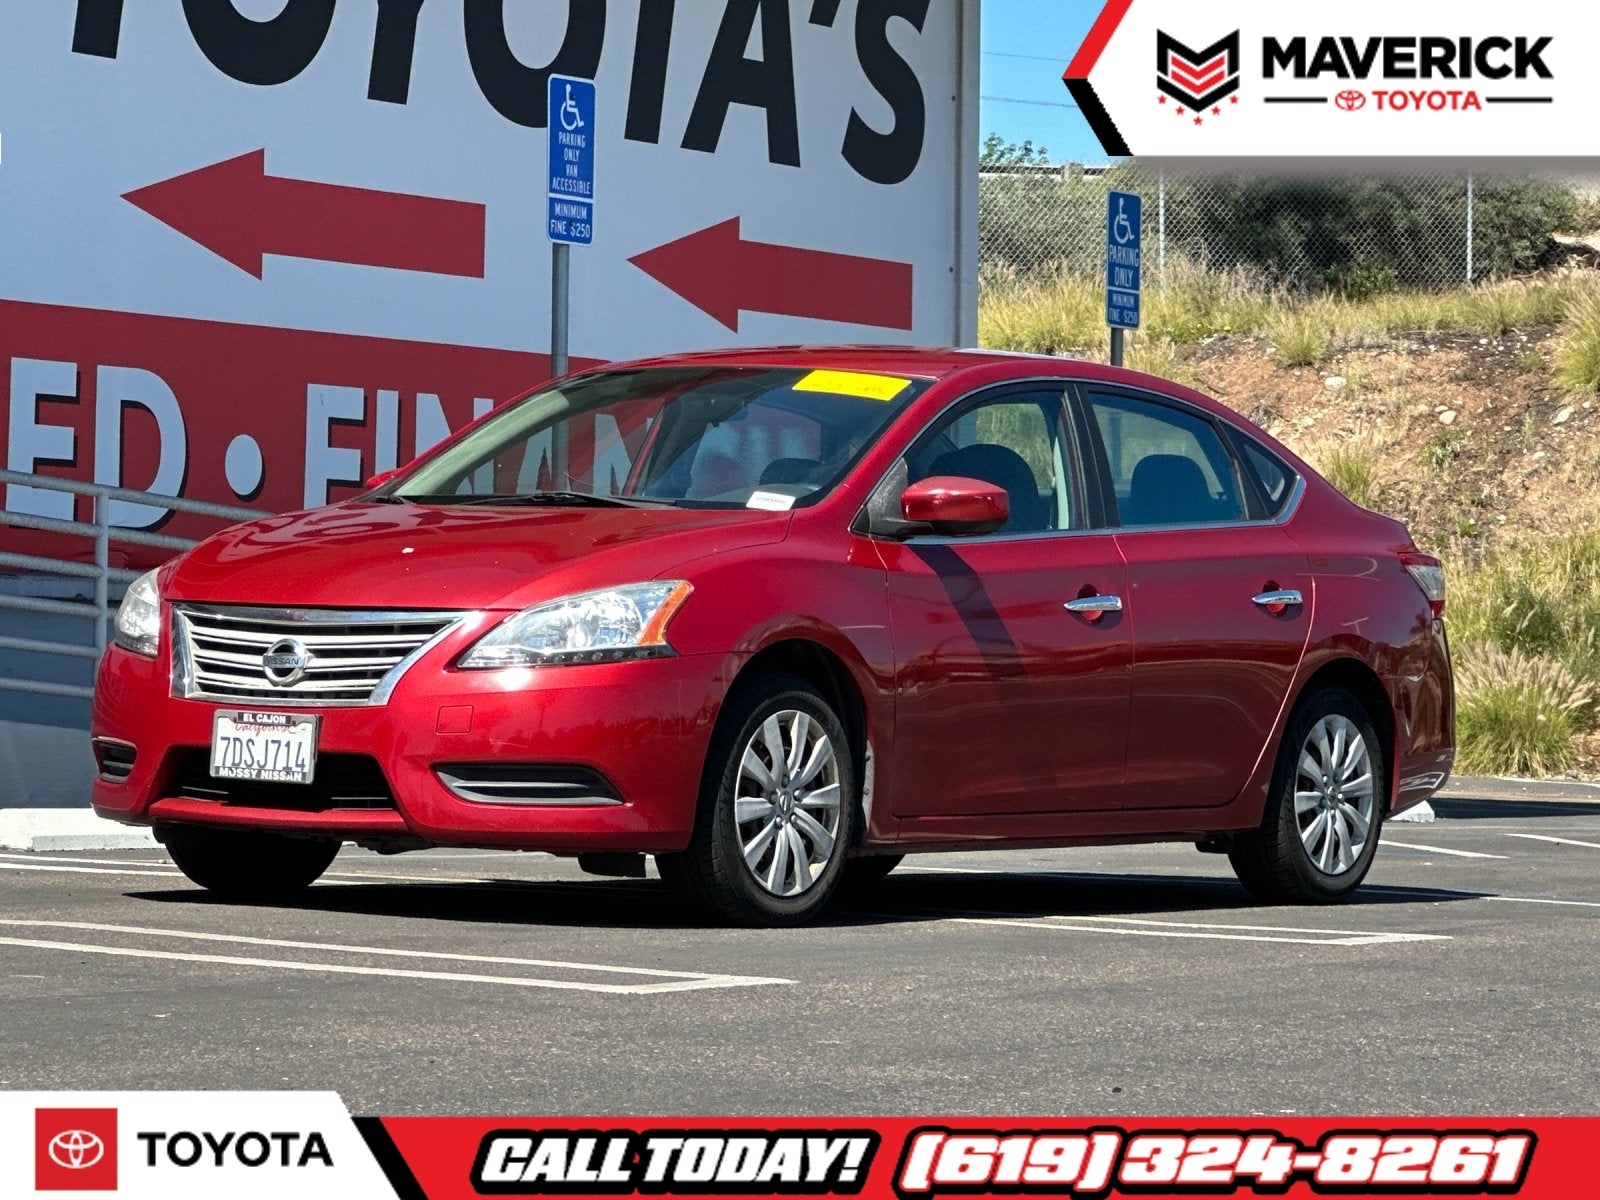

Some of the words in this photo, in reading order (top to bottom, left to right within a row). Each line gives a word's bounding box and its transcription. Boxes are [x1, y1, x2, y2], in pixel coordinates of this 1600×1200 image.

[72, 0, 927, 184] OTAS
[558, 131, 586, 148] PARKING
[563, 148, 580, 162] ONLY
[565, 163, 578, 177] VAN
[552, 177, 591, 195] ACCESSIBLE
[554, 202, 587, 220] MINIMUM
[550, 219, 567, 235] FINE
[570, 221, 591, 238] $250
[1109, 244, 1139, 267] PARKING
[1114, 266, 1134, 287] ONLY
[265, 656, 300, 666] NISSAN
[243, 713, 254, 722] EL
[256, 714, 286, 724] CAJON
[219, 736, 306, 772] 7DSJ714
[219, 767, 258, 779] MOSSY
[261, 769, 302, 782] NISSAN
